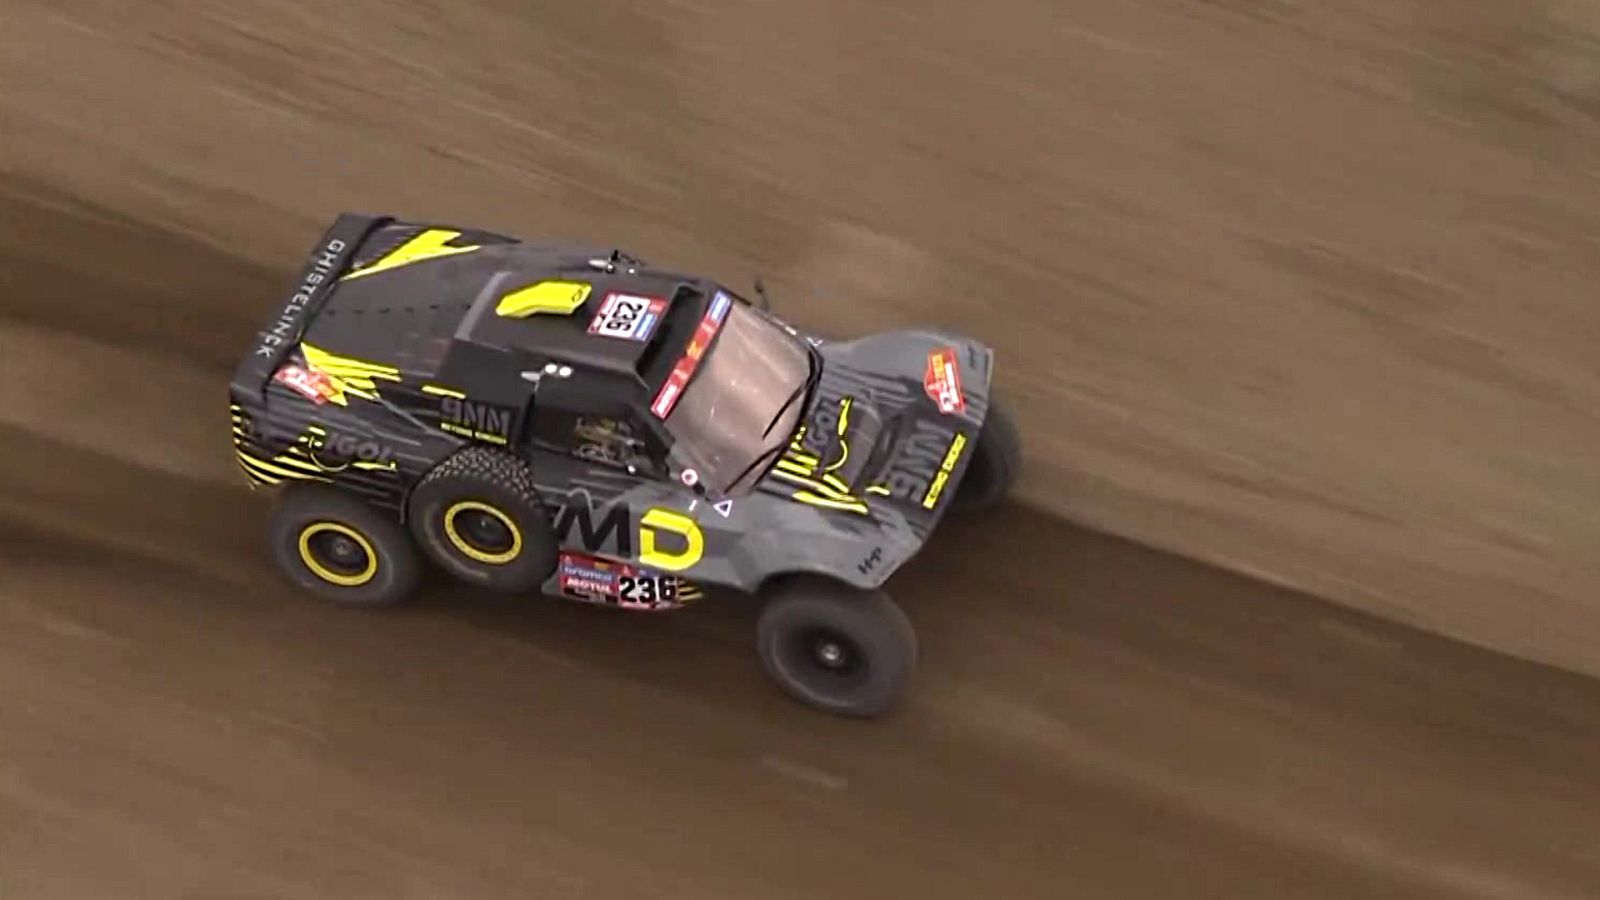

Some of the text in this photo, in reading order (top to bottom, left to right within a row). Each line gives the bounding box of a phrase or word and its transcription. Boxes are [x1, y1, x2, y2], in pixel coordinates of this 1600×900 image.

[255, 238, 346, 358] GHISTELINCK
[606, 300, 644, 331] 236
[618, 575, 677, 604] 236
